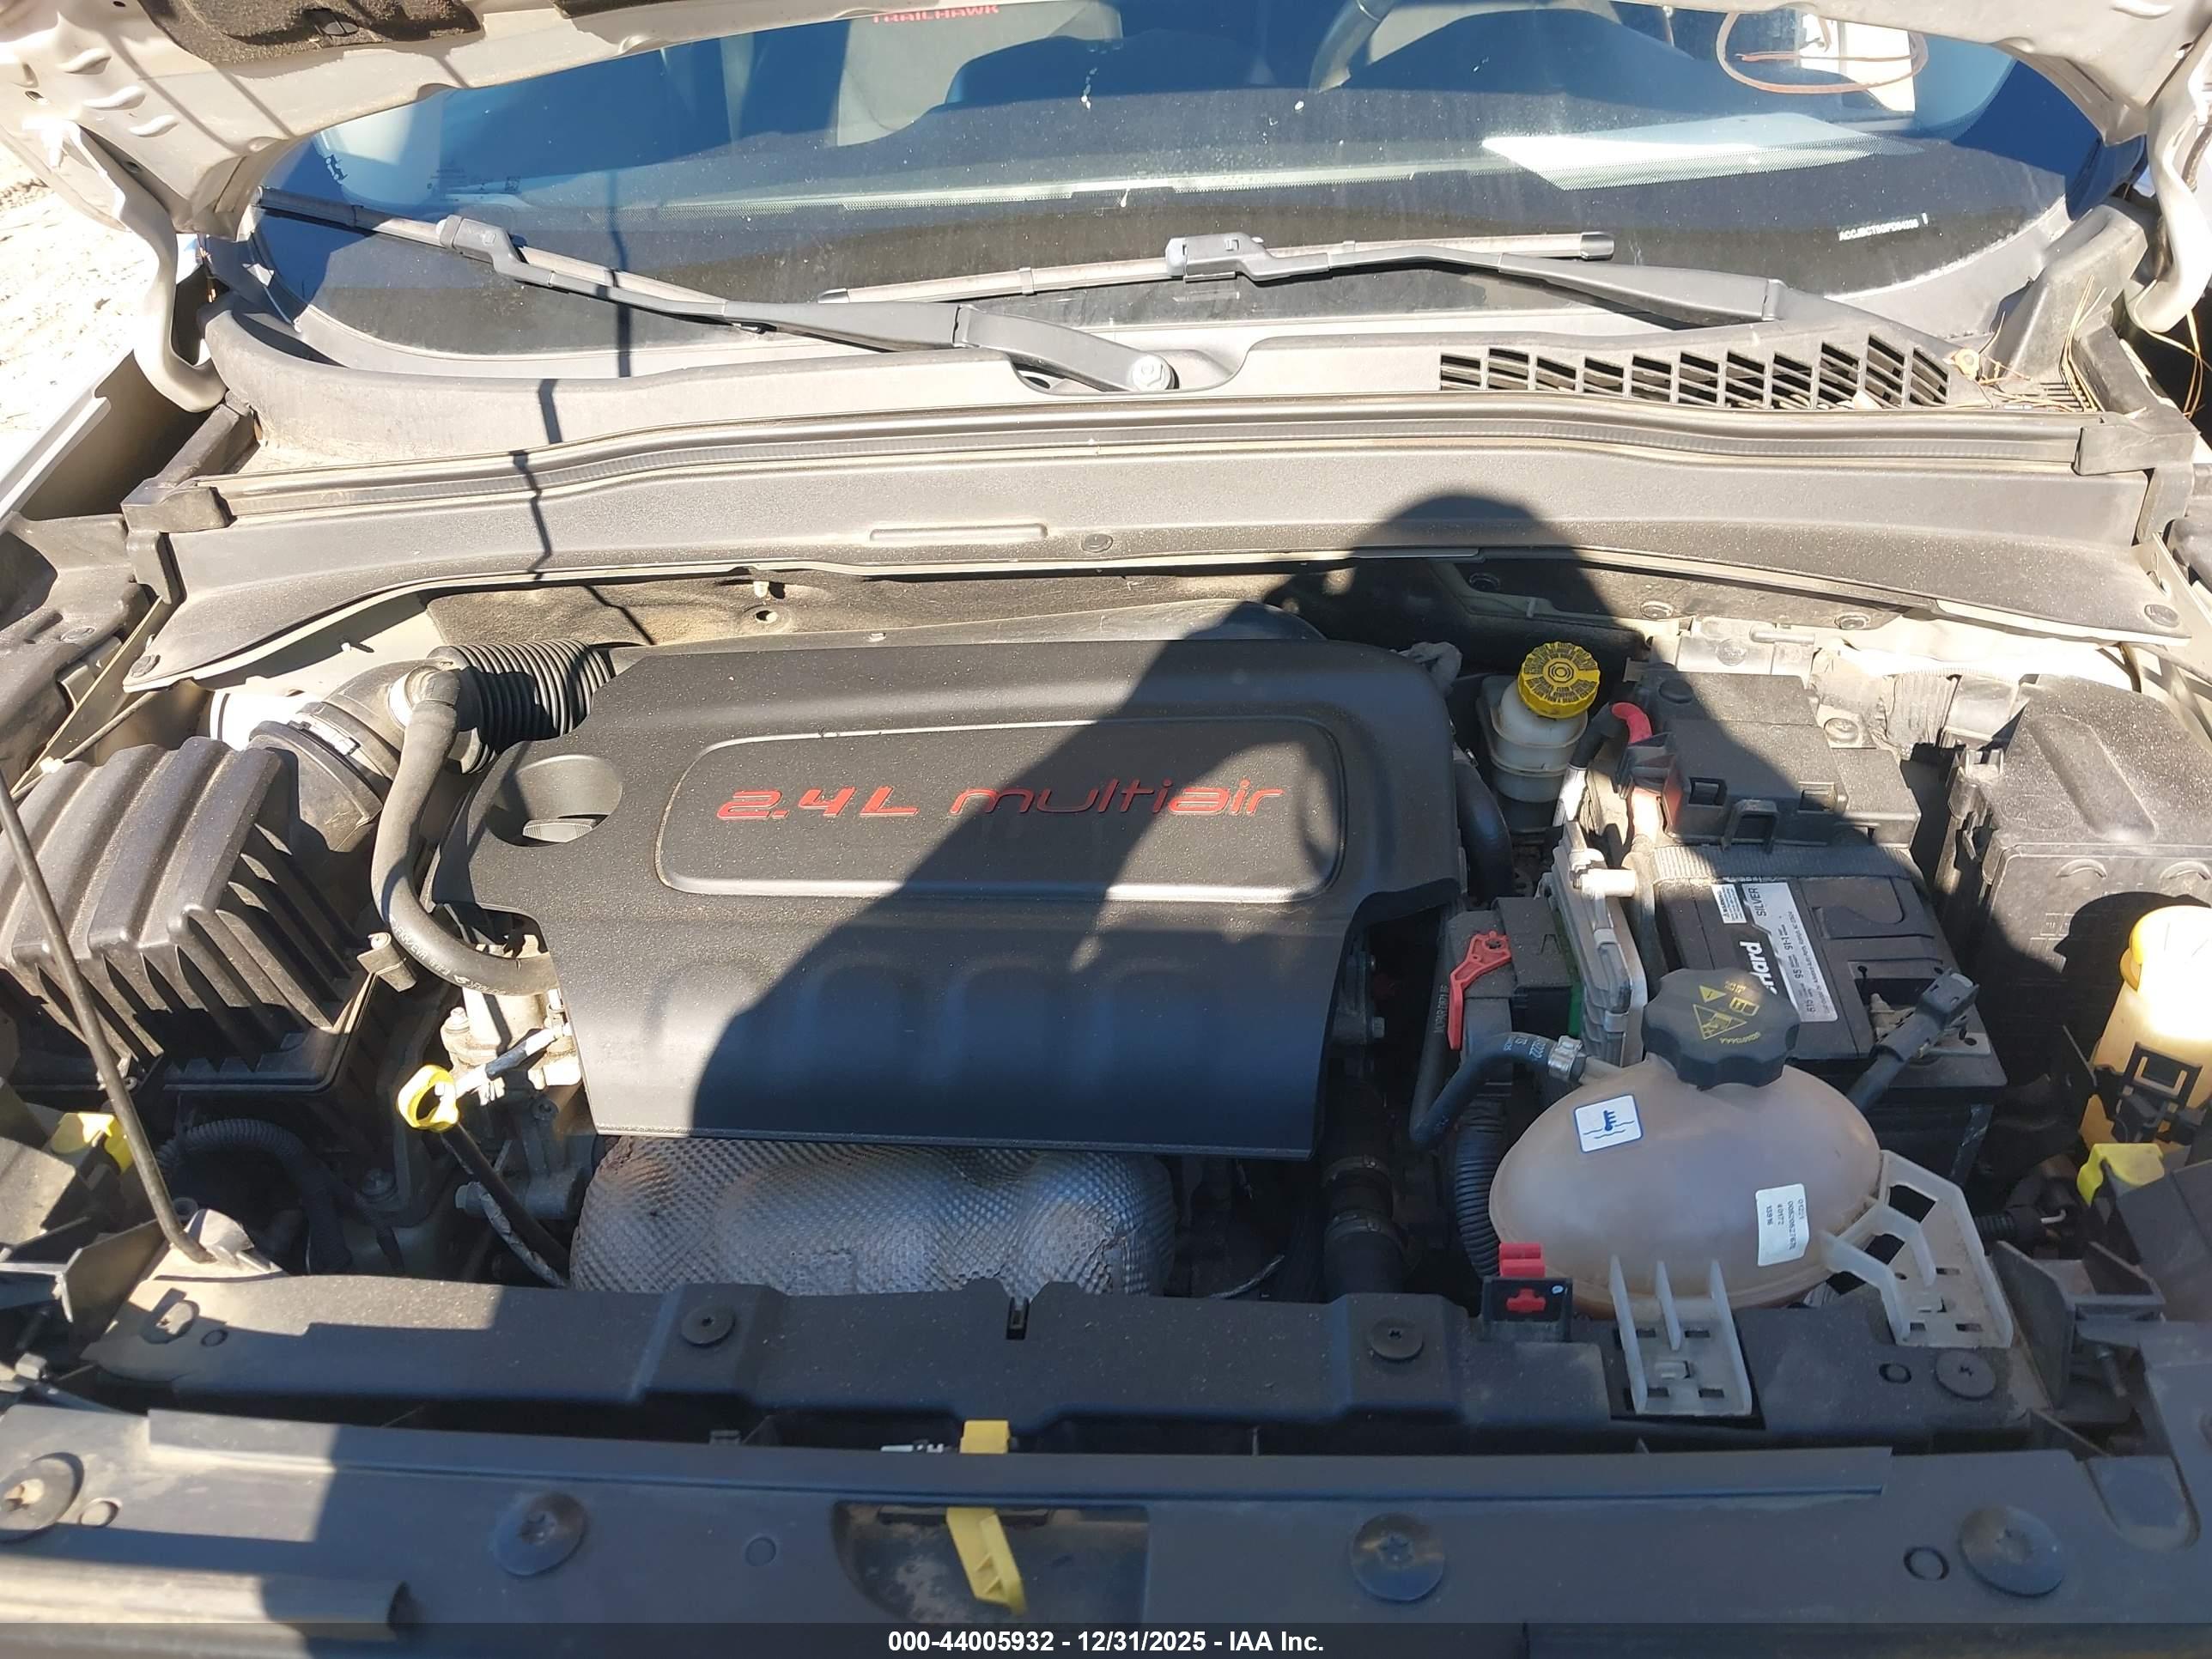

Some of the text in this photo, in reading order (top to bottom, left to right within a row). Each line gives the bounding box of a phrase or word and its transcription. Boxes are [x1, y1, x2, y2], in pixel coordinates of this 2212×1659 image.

[716, 777, 1284, 820] 2.4L multiair
[1748, 887, 1767, 917] SILVER
